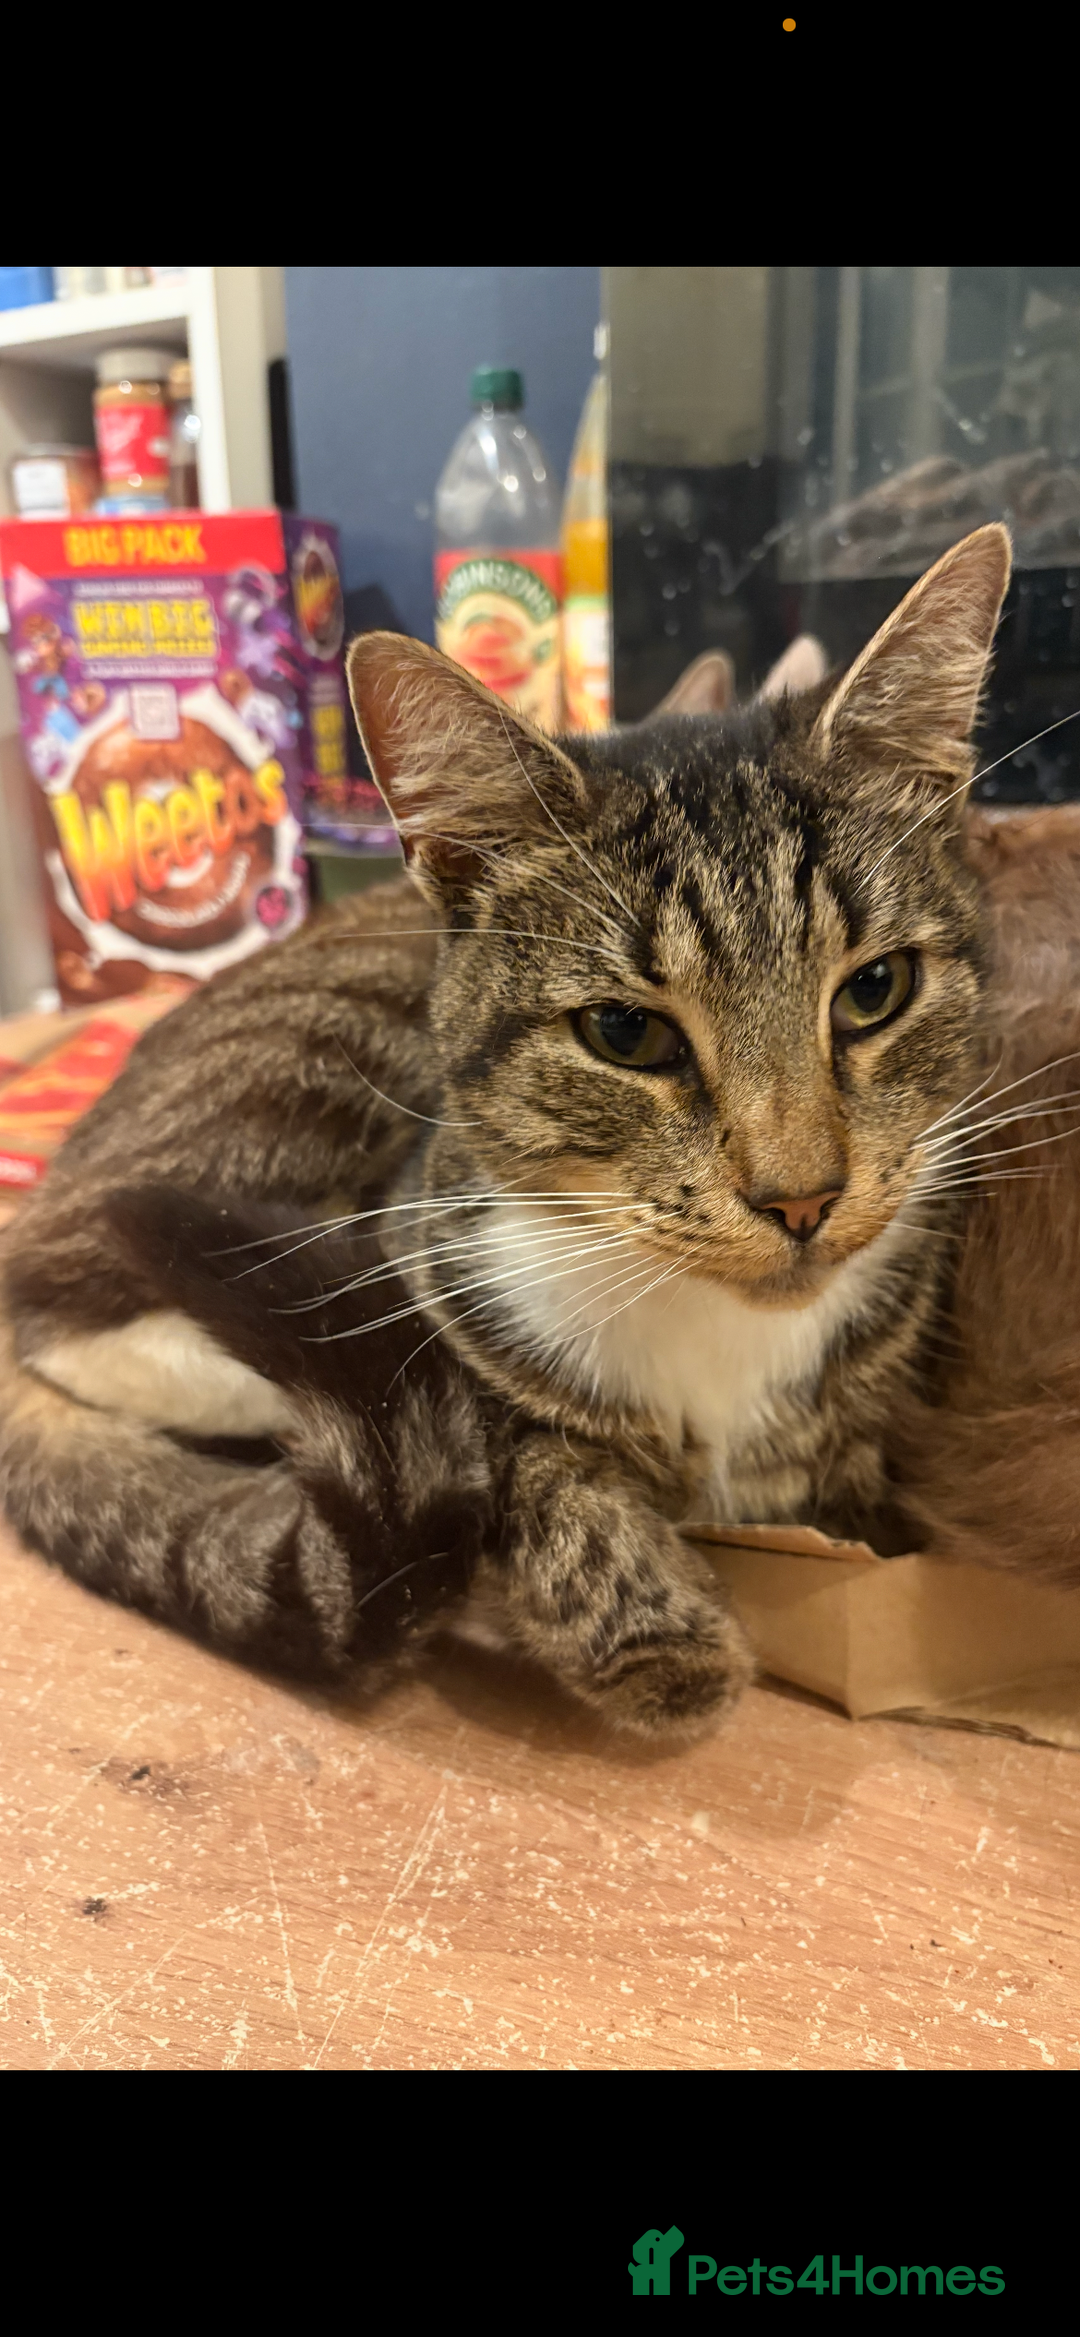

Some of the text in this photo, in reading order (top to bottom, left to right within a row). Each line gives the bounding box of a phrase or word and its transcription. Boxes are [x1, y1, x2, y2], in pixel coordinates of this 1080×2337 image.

[64, 524, 206, 567] BIG PACK
[53, 761, 288, 924] Weetos
